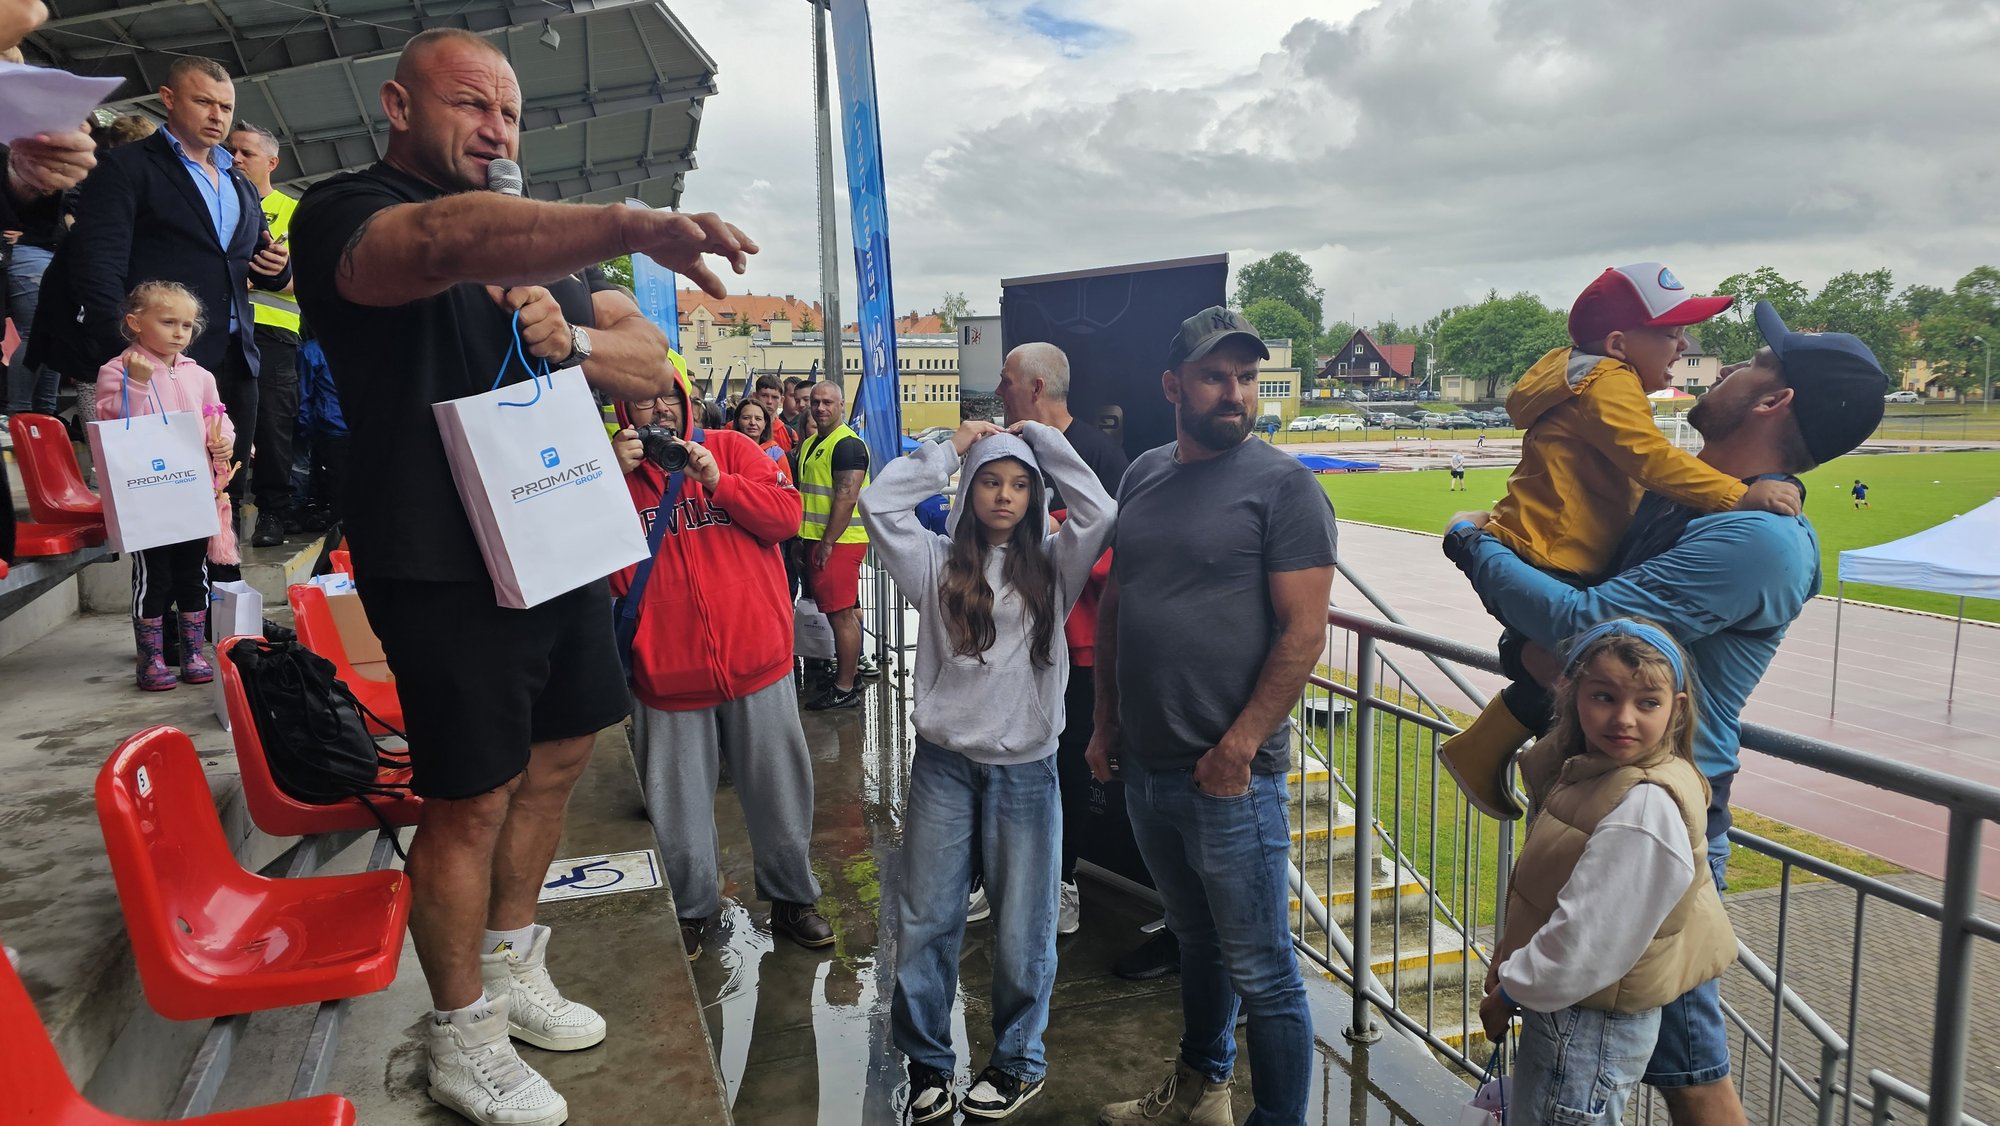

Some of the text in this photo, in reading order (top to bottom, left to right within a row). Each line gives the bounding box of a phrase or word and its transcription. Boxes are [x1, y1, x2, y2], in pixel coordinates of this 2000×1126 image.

[127, 469, 197, 487] PROMATIC
[175, 476, 197, 484] GROUP
[510, 459, 601, 500] PROMATIC
[575, 471, 603, 485] GROUP
[640, 498, 732, 540] EVILS
